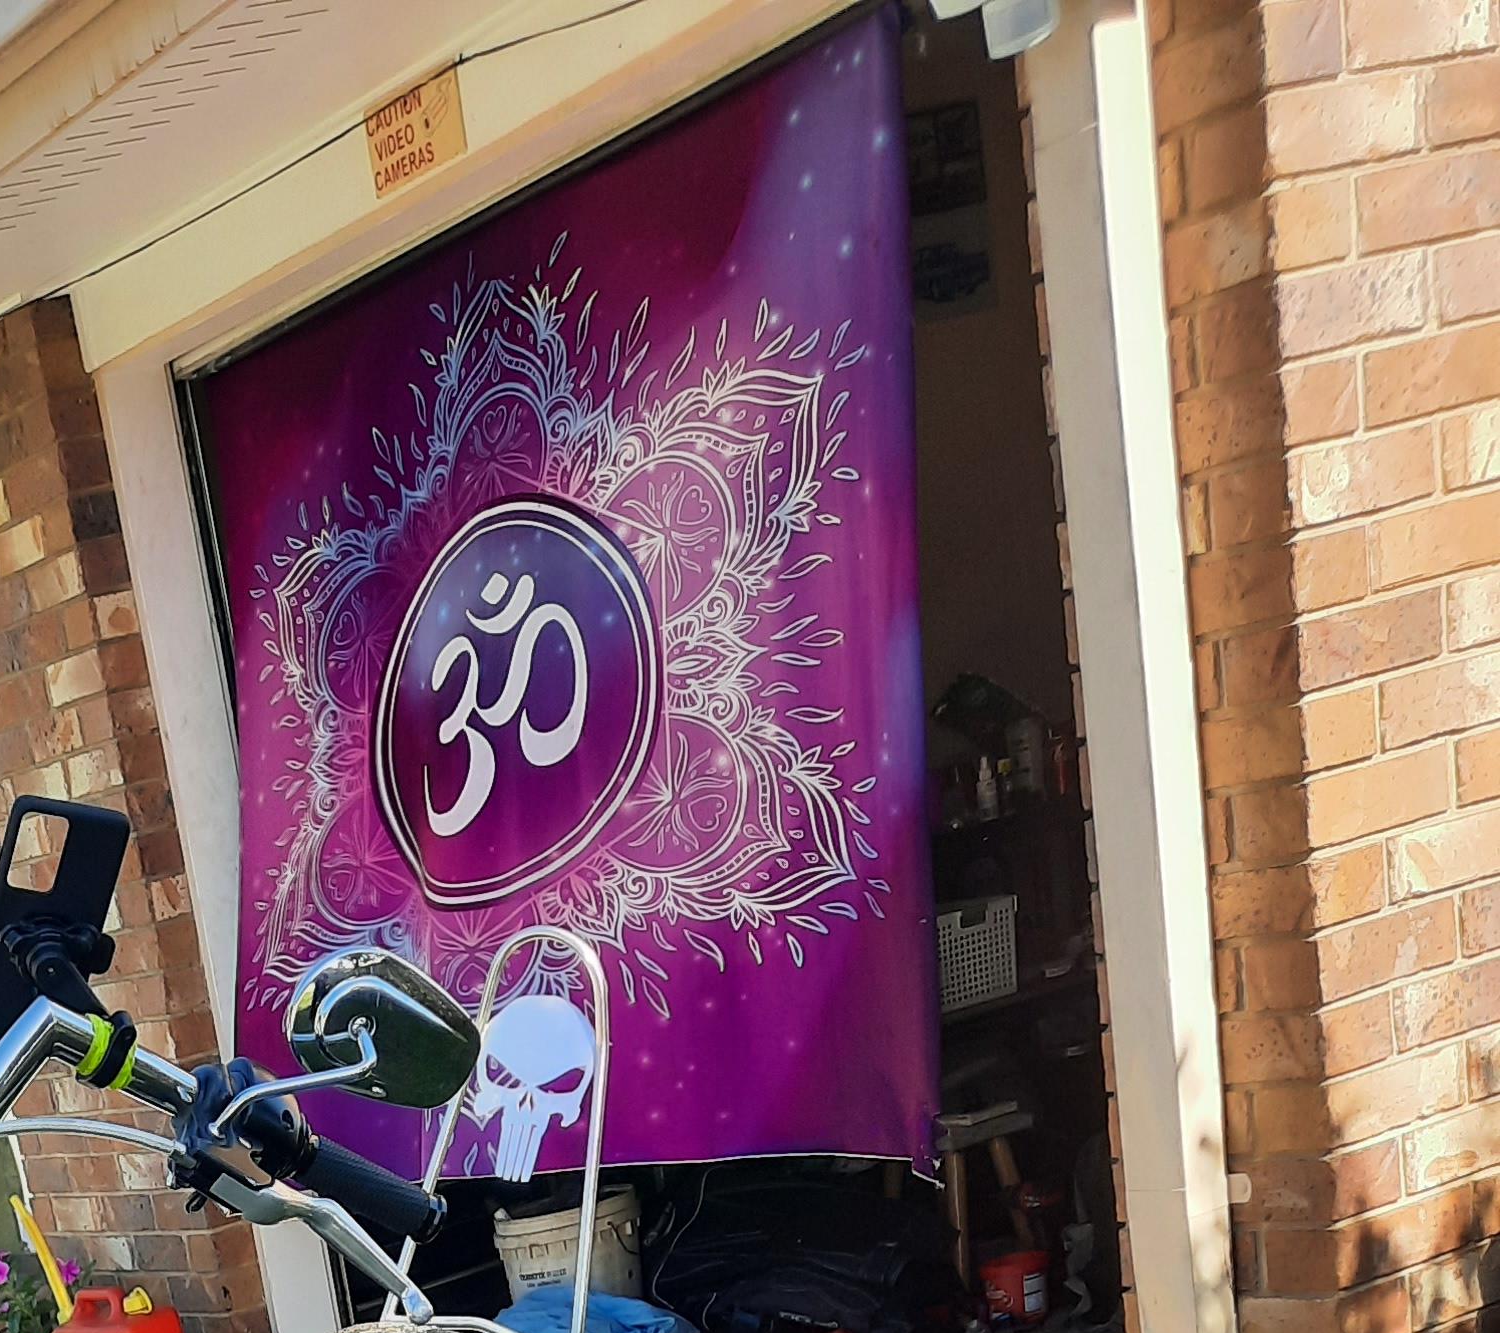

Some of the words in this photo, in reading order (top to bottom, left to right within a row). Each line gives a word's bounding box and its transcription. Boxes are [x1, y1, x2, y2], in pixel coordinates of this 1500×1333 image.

[365, 89, 422, 137] CAUTION
[374, 123, 415, 162] VIDEO
[374, 141, 435, 192] CAMERAS
